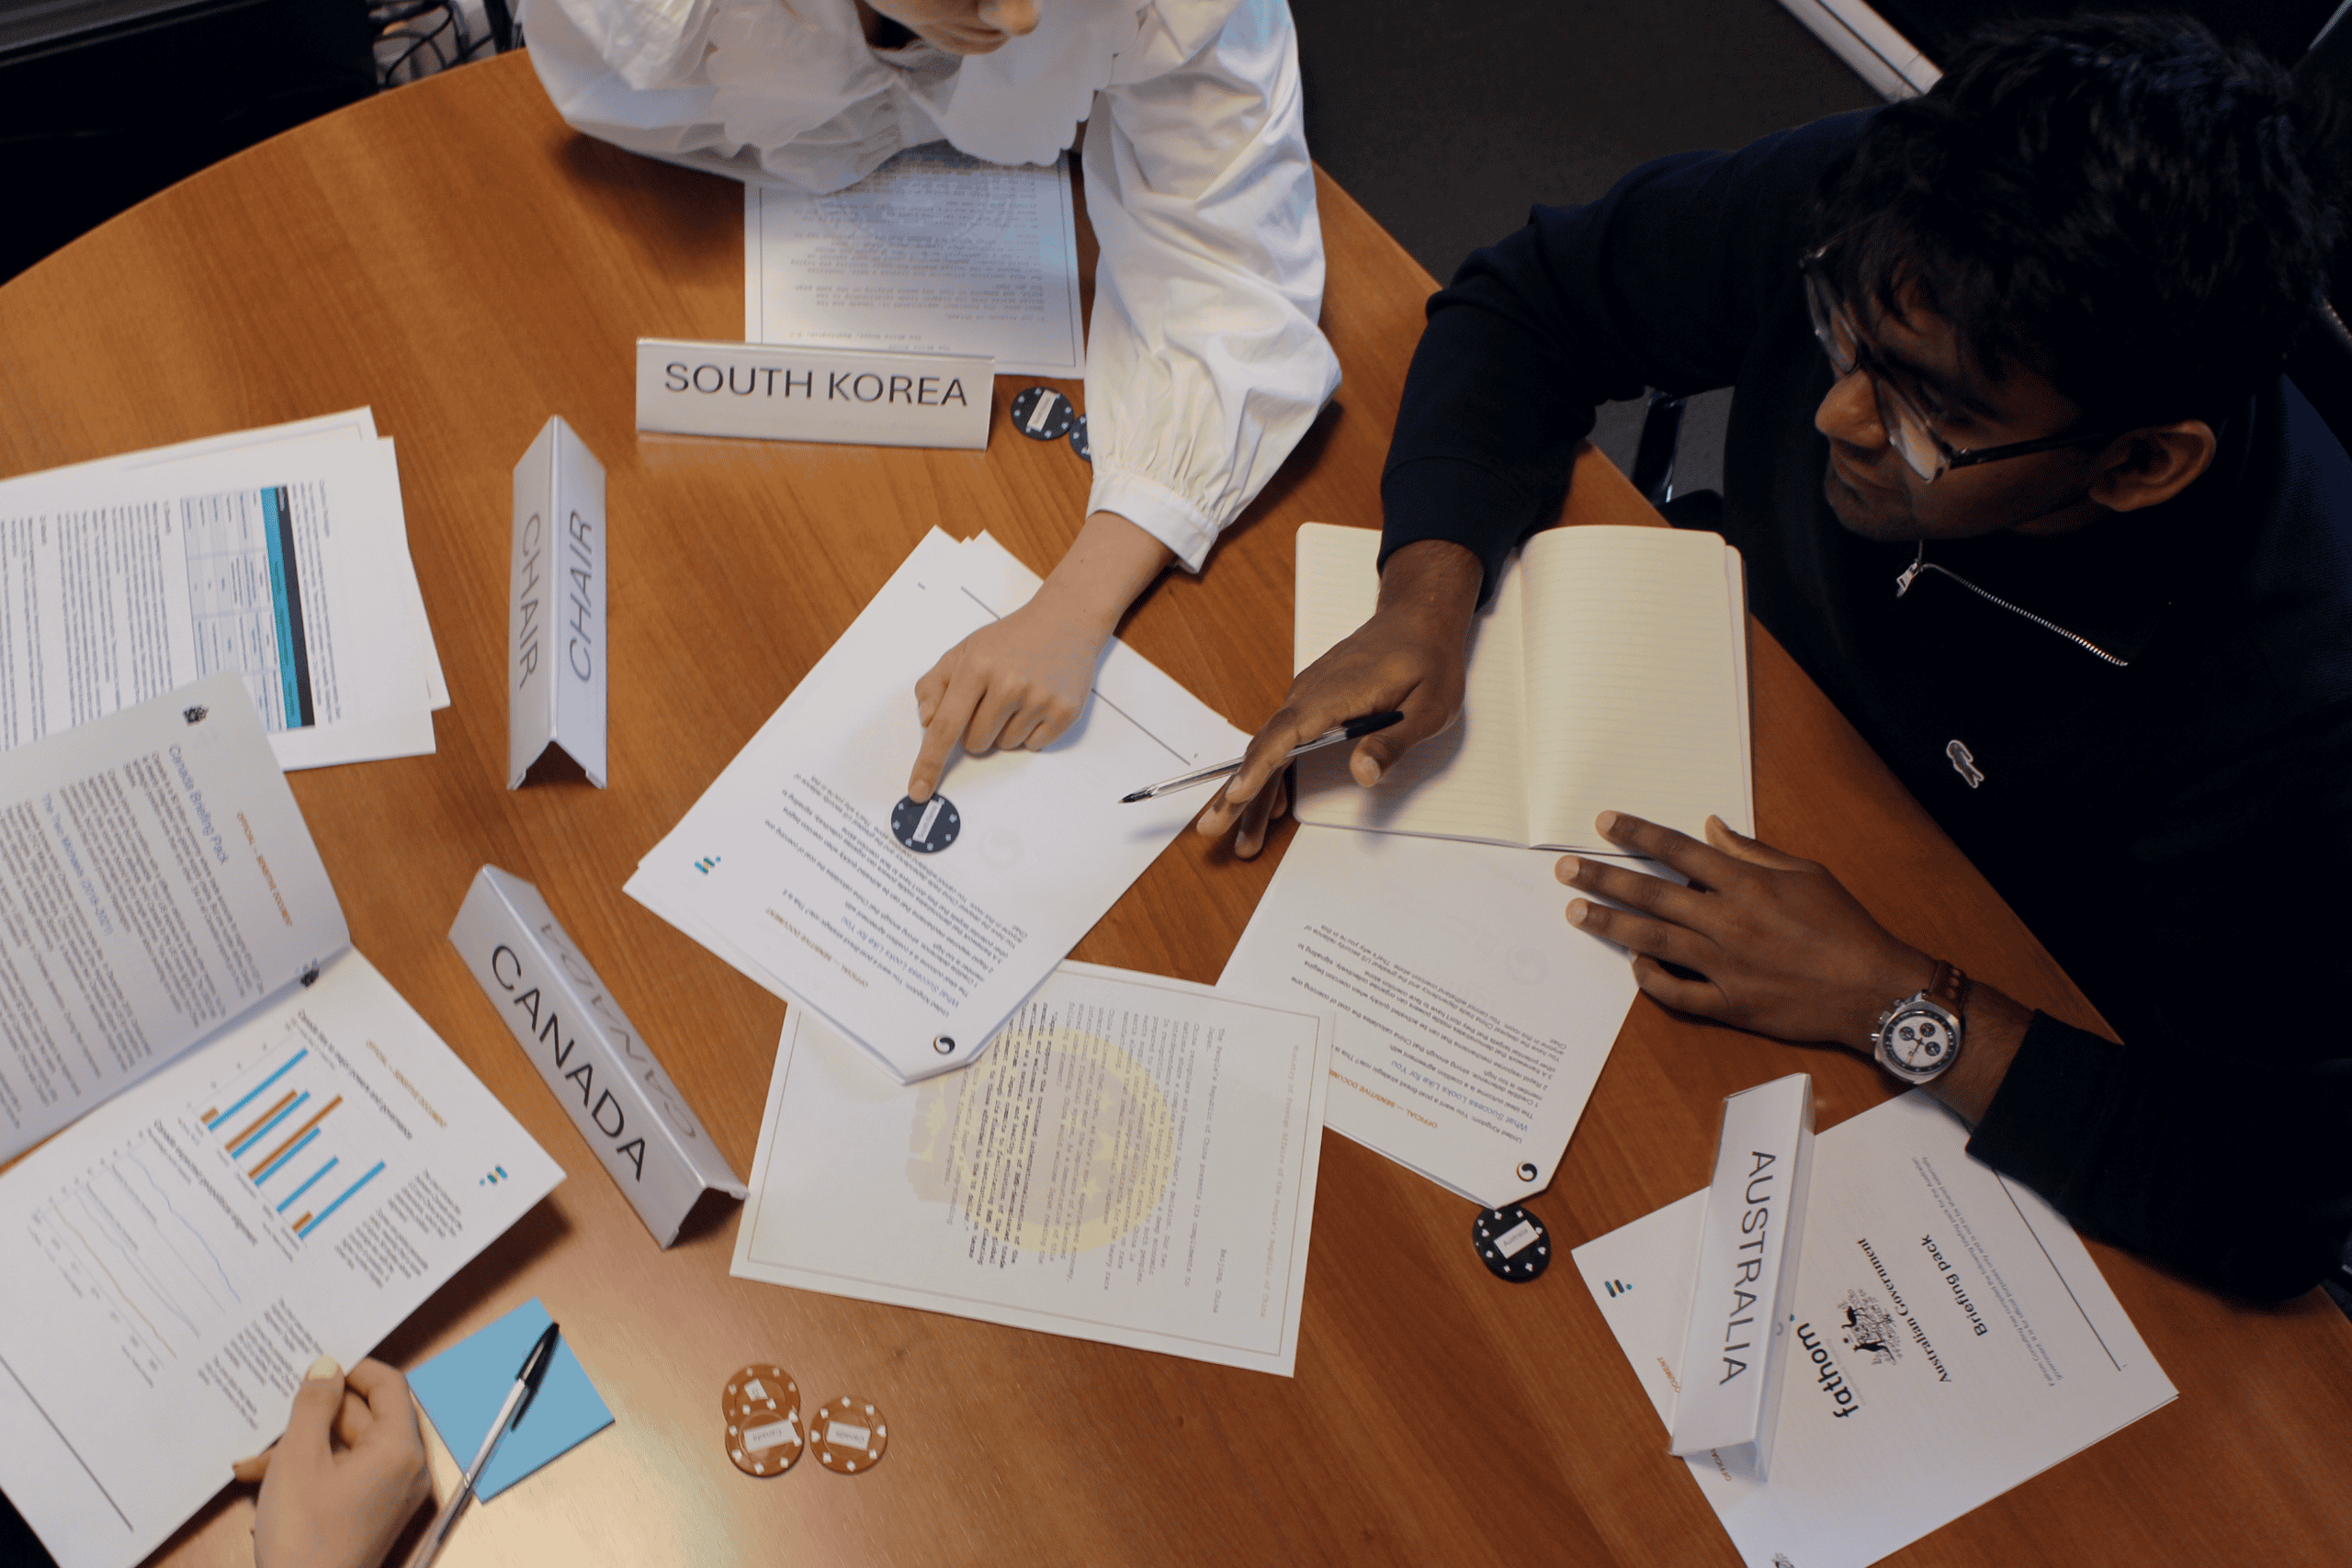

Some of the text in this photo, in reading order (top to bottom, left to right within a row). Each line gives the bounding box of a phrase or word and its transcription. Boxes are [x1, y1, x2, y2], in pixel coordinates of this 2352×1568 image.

[664, 362, 968, 407] SOUTH KOREA
[520, 512, 540, 689] CHAIR
[570, 509, 593, 682] CHAIR
[492, 945, 646, 1183] CANADA
[540, 922, 696, 1138] CANADA
[1328, 1067, 1437, 1128] OFFICIAL SENSITIVE DOCUME
[1390, 1060, 1527, 1132] What Success Looks Like for You
[1503, 1229, 1528, 1247] Australia
[1719, 1151, 1776, 1385] AUSTRALIA
[1921, 1234, 1987, 1336] Briefing pack
[1857, 1238, 1951, 1382] Australian Government
[1657, 1356, 1680, 1393] OCUMENT
[1796, 1323, 1858, 1417] fathom
